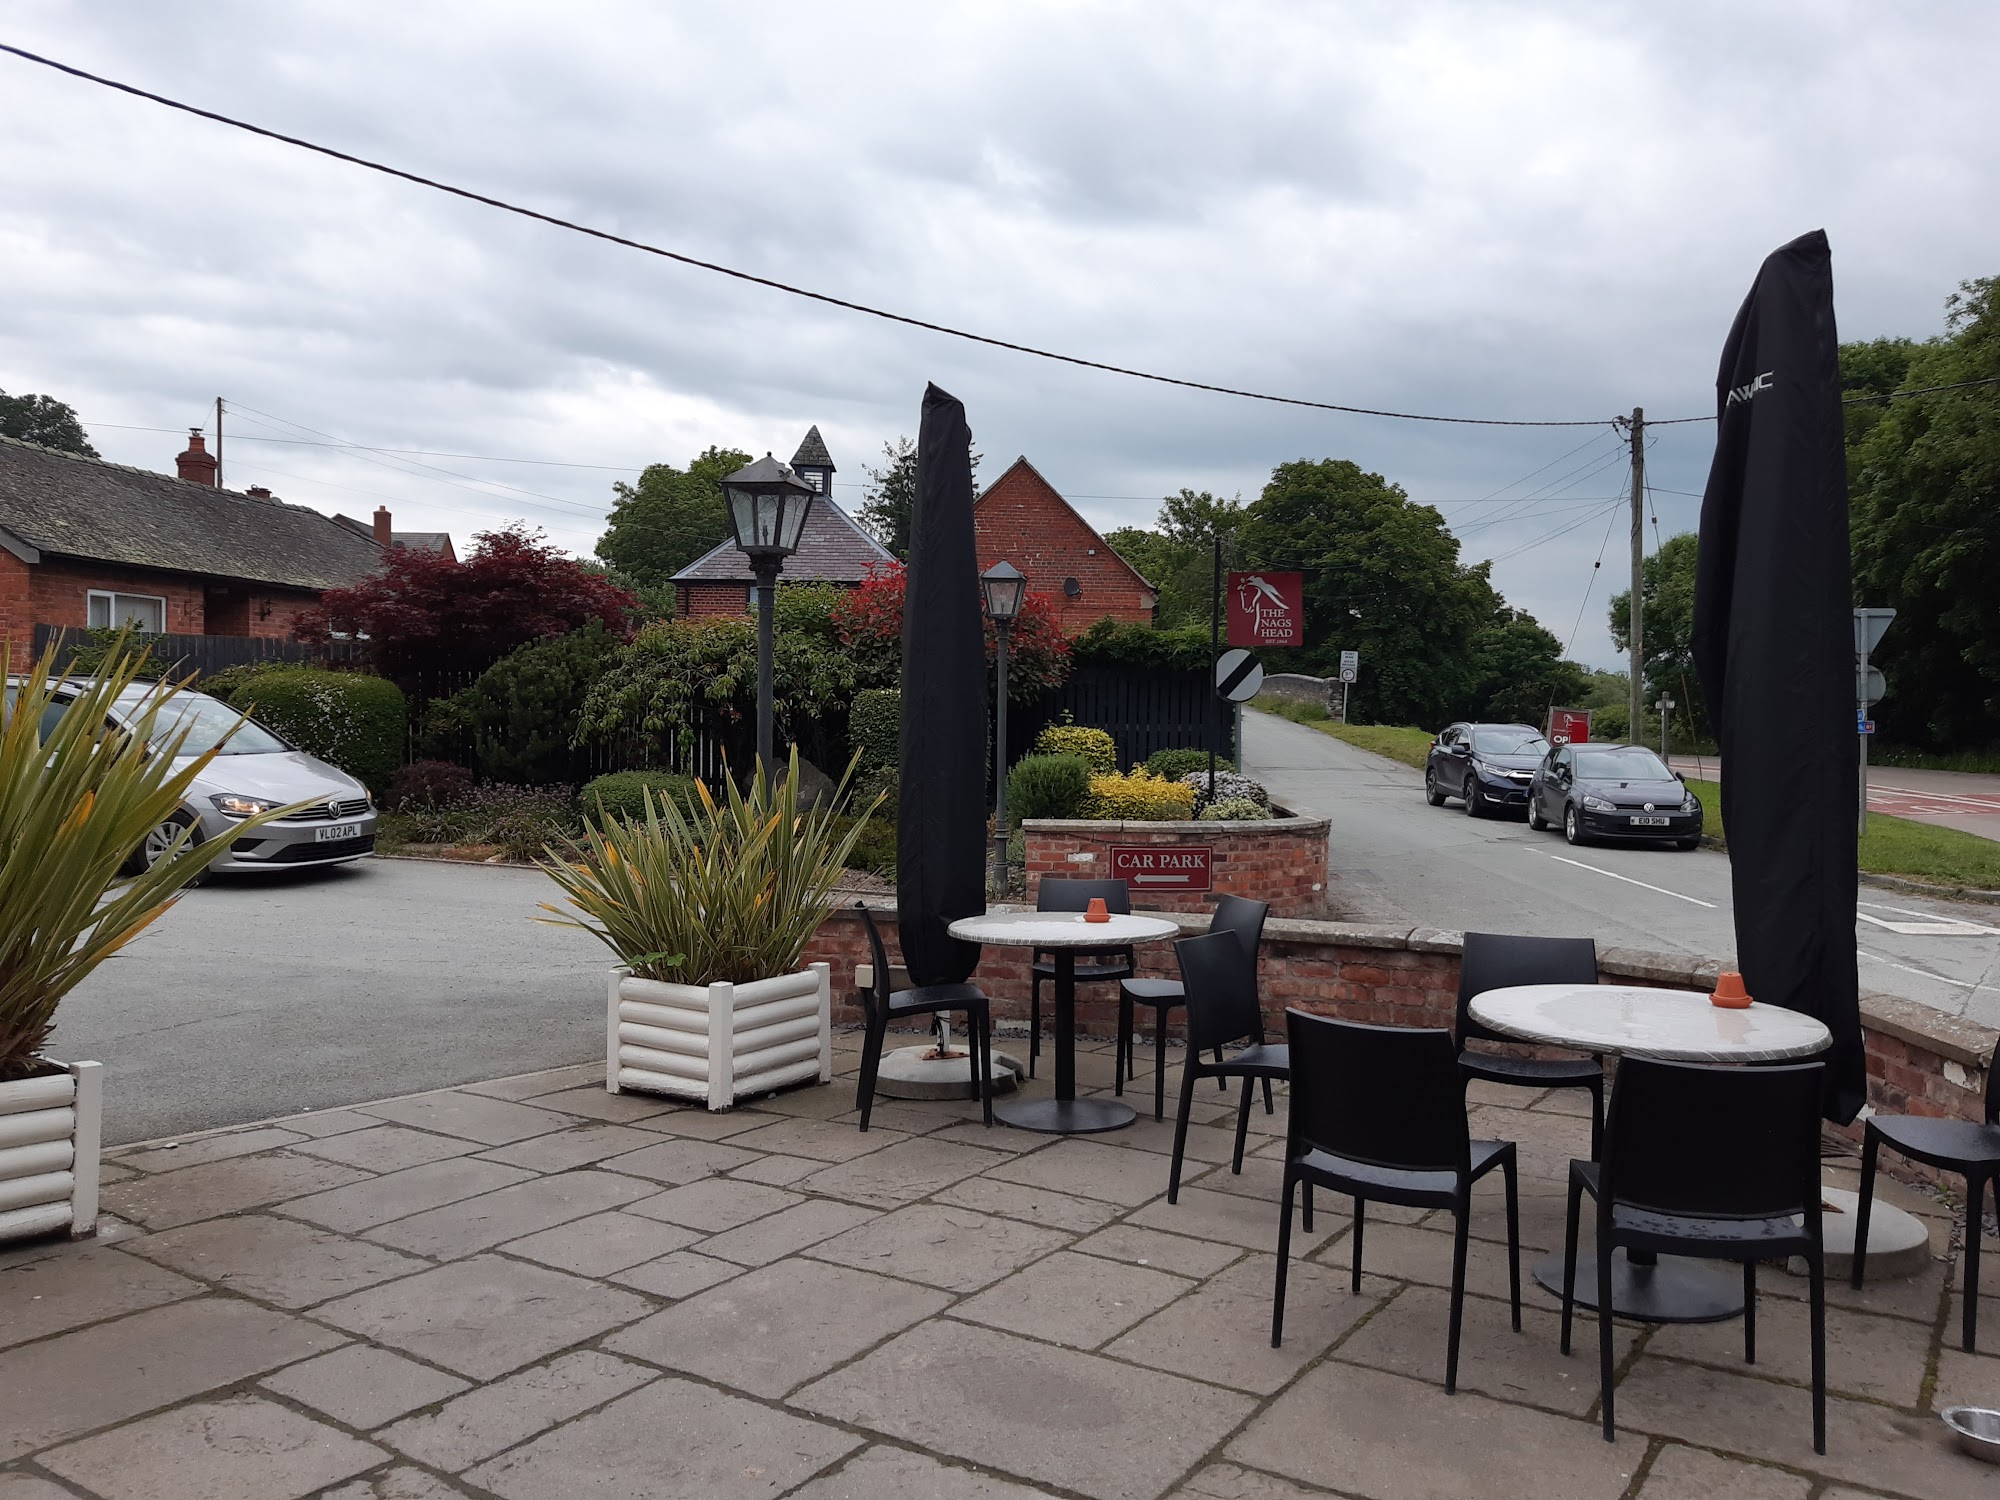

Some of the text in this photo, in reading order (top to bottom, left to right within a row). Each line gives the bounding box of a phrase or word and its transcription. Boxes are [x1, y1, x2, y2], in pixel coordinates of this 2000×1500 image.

[1261, 609, 1285, 617] THE
[1261, 619, 1292, 627] NAGS
[1261, 629, 1293, 637] HEAD
[342, 825, 357, 837] APL
[1117, 854, 1205, 868] CAR PARK
